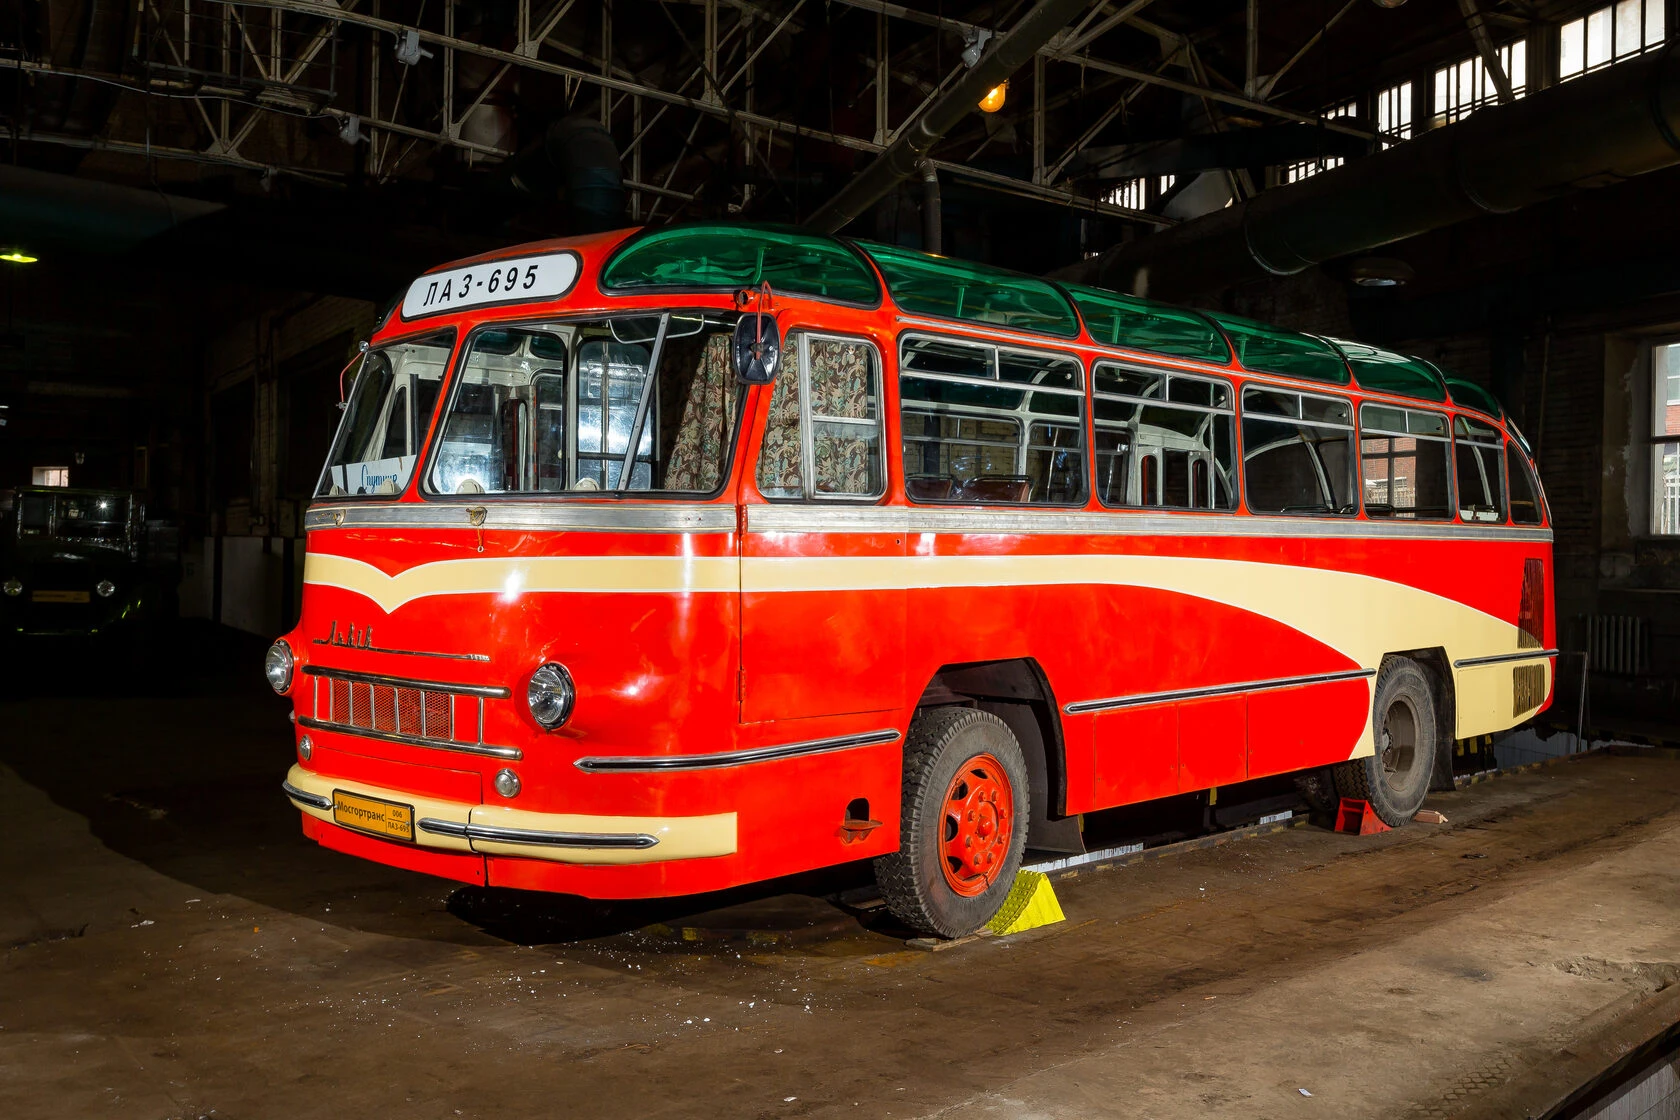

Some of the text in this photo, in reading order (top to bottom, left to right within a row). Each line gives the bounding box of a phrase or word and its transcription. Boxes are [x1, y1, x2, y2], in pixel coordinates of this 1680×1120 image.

[422, 264, 539, 307] ЛАЗ-695
[361, 463, 398, 494] Спутк
[336, 800, 386, 822] Мосгортранс
[391, 808, 403, 819] 006
[387, 821, 410, 833] ЛАЗ-695
